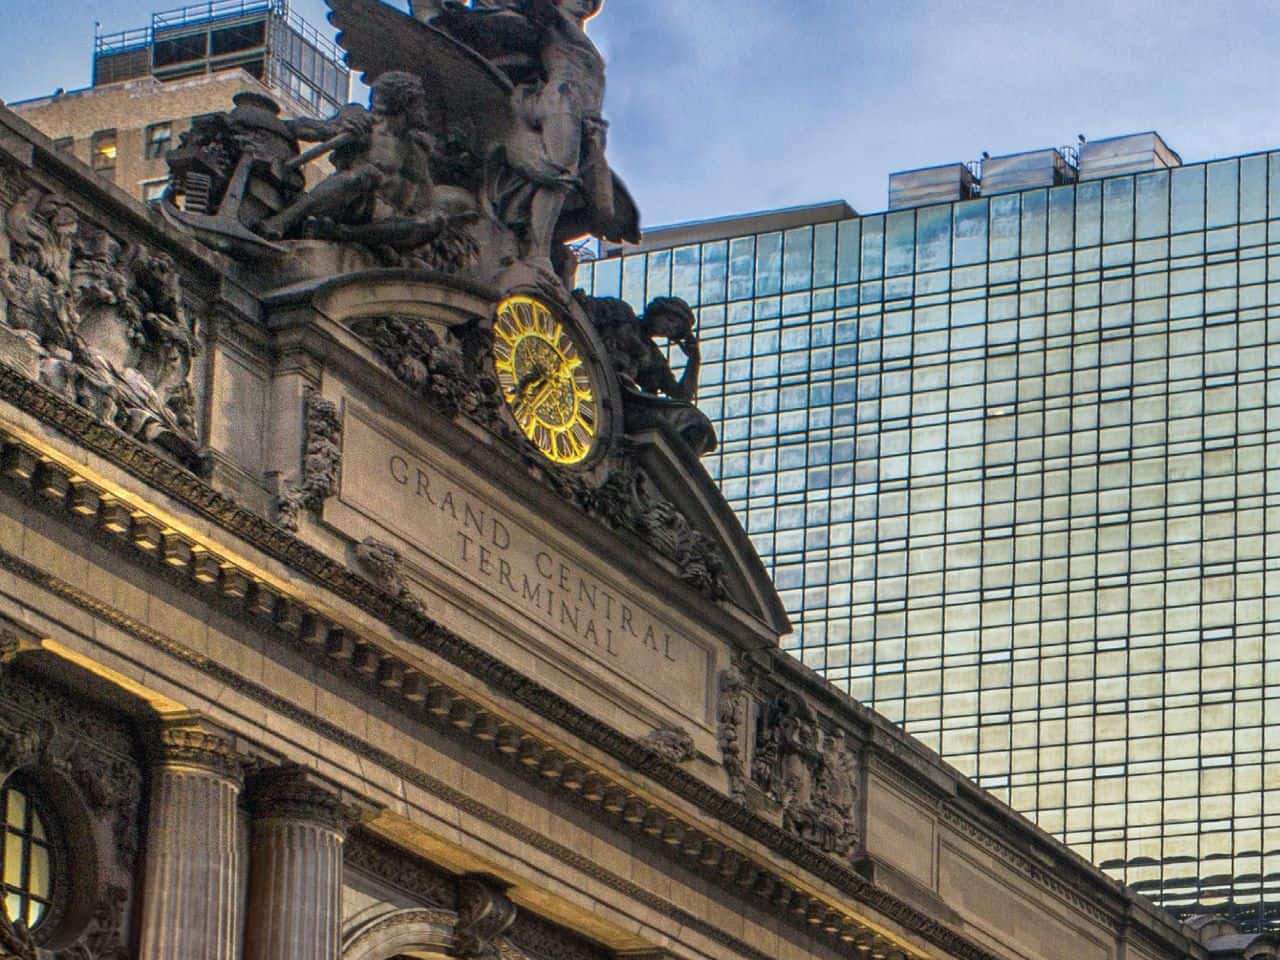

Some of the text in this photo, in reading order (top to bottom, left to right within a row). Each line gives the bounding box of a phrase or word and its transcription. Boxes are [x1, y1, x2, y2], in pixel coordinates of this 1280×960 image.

[389, 455, 676, 662] GRAND CENTRAL
[456, 531, 618, 657] TERMINAL
